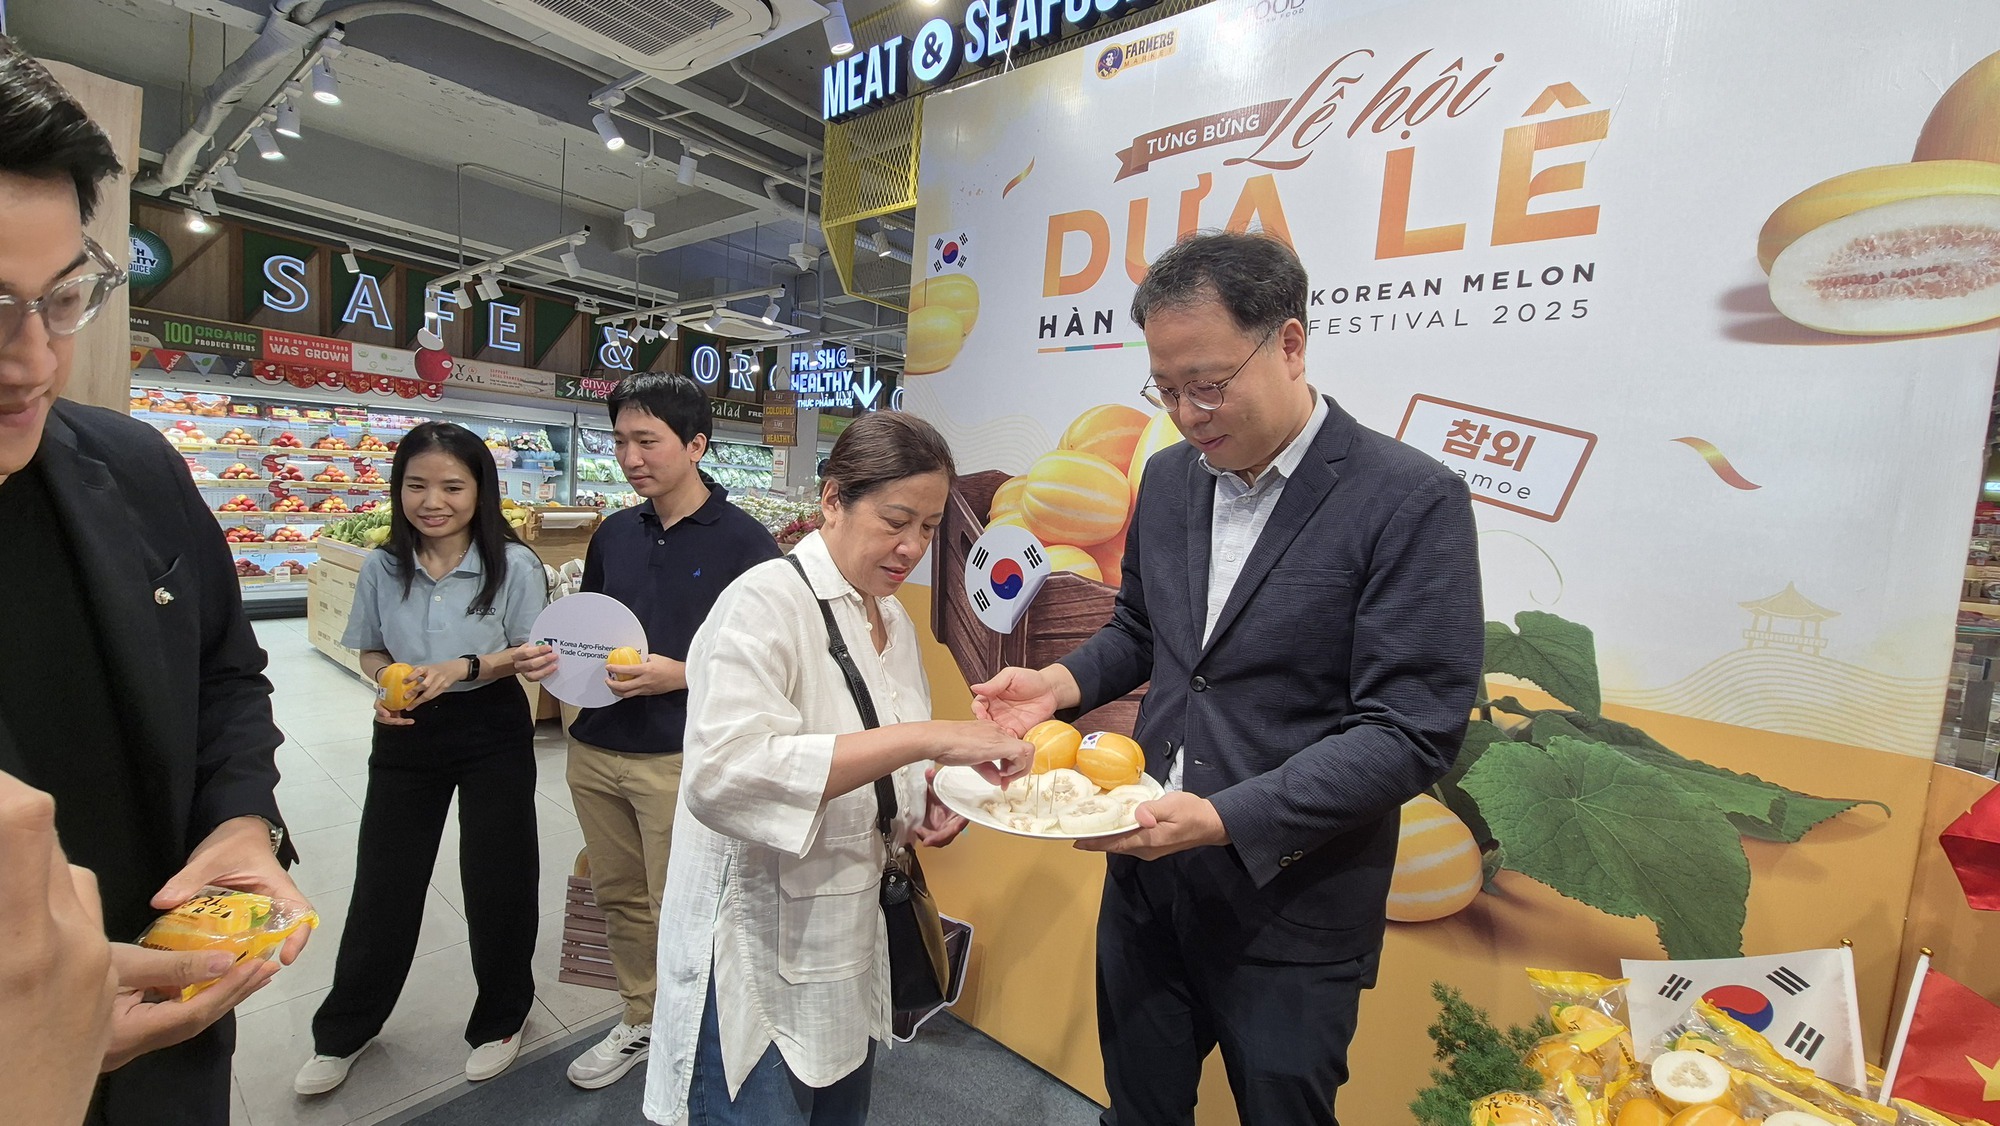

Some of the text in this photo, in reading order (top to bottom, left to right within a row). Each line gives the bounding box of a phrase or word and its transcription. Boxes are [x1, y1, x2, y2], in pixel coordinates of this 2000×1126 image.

[1124, 47, 1172, 67] MARKET
[1126, 31, 1175, 59] FARMERS
[823, 36, 903, 120] MEAT
[1223, 48, 1505, 170] Lễ hội
[1147, 112, 1261, 156] TƯNG BỪNG
[1374, 80, 1611, 261] LÊ
[1310, 262, 1596, 306] KOREAN MELON
[263, 254, 521, 352] SAFE
[600, 325, 633, 371] &
[1038, 306, 1114, 339] HÀN
[1308, 299, 1589, 336] FESTIVAL 2025
[163, 321, 194, 345] 100
[195, 325, 257, 344] ORGANIC
[195, 338, 256, 353] PRODUCE ITEMS
[269, 343, 350, 363] WAS GROWN
[791, 348, 836, 372] FRSH
[581, 378, 610, 396] envy
[790, 370, 854, 394] HEALTHY
[766, 406, 793, 415] COLORFUL
[766, 434, 791, 443] HEALTHY
[1441, 418, 1537, 473] 참외
[560, 640, 578, 648] Korea
[578, 642, 617, 652] Agro-Fisherie
[560, 648, 609, 660] Trade Corporatio
